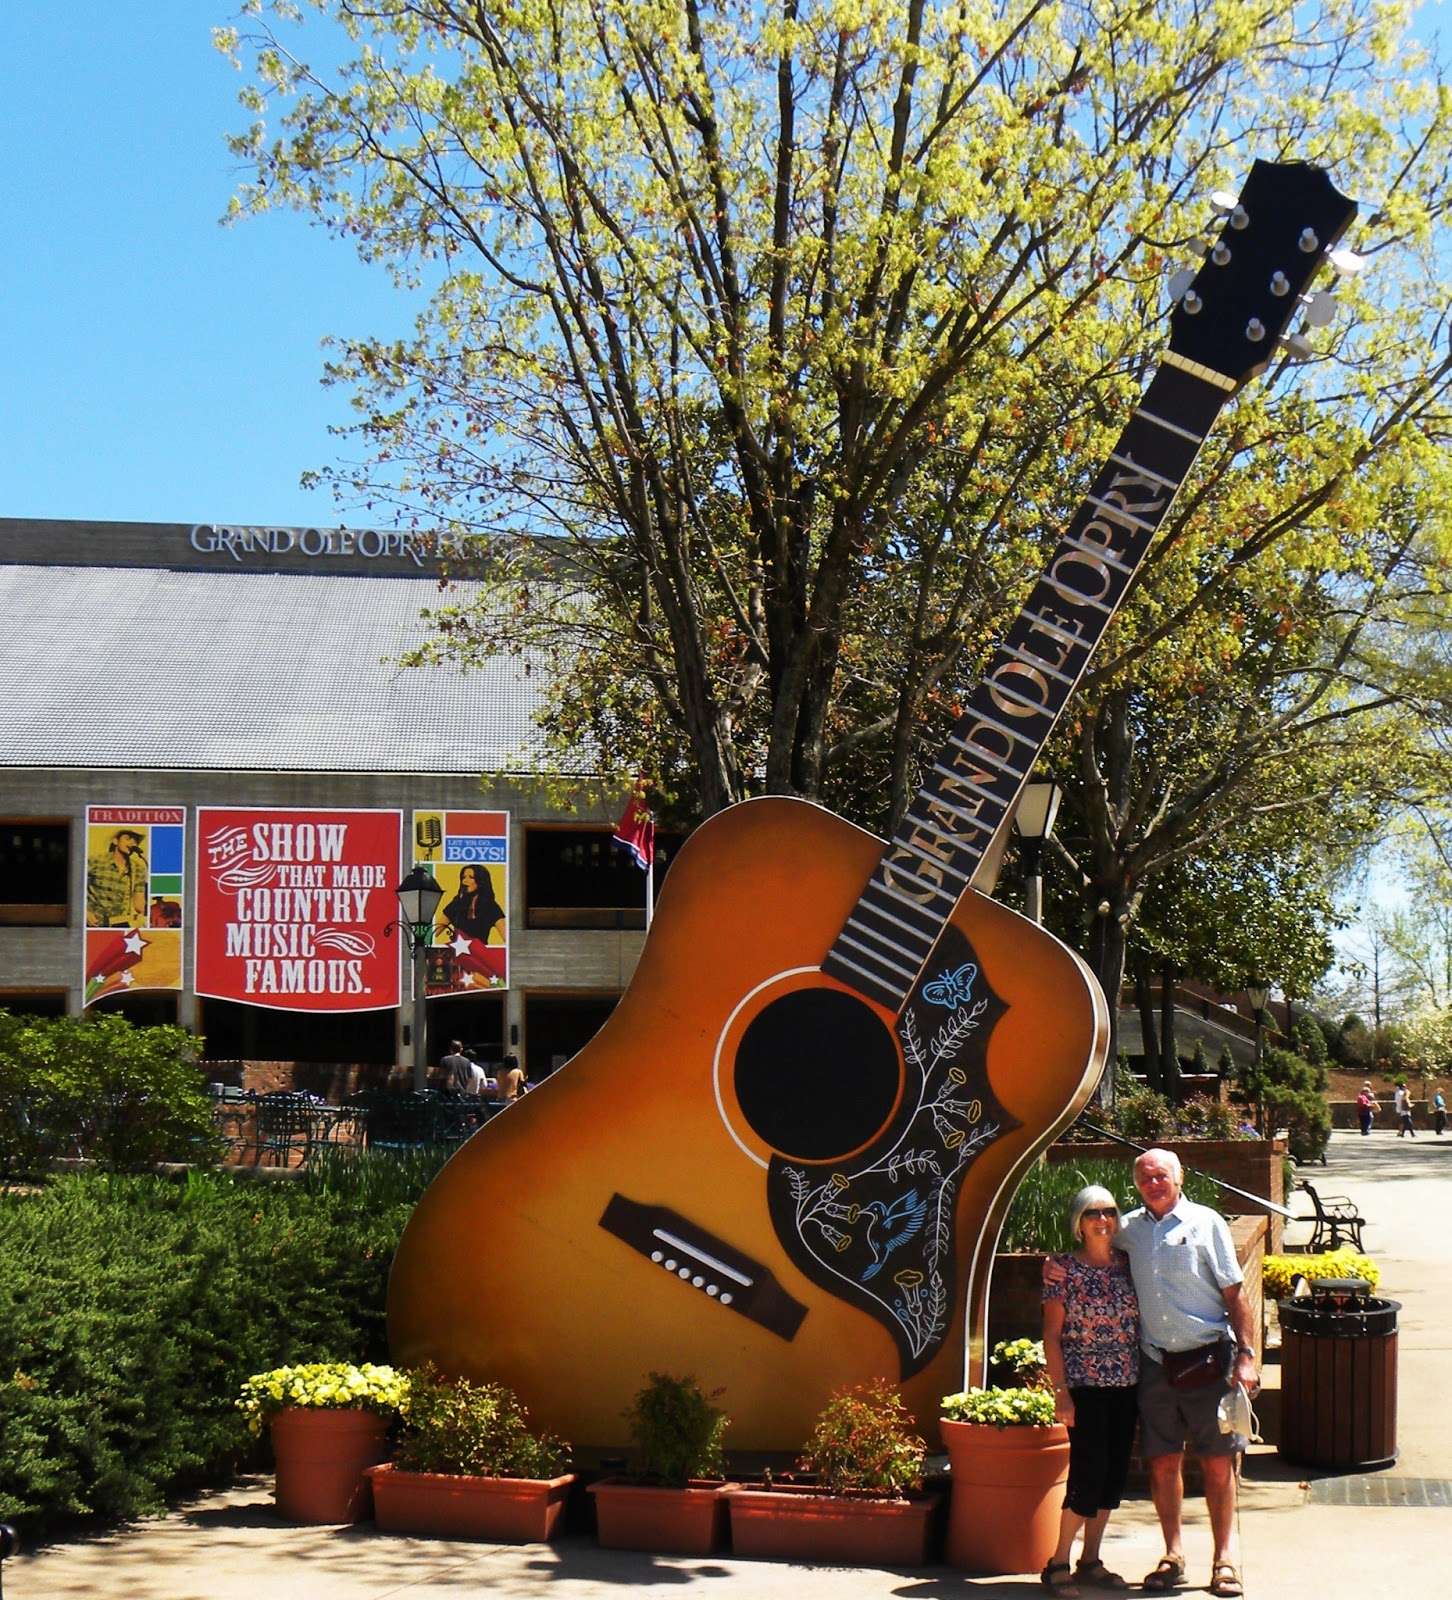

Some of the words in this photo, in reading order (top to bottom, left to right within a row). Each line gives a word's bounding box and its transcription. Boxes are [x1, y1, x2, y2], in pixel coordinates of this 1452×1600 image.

[190, 524, 294, 561] GRAND
[300, 528, 354, 556] OLE
[884, 721, 1014, 904] GRAND
[989, 606, 1084, 718] OLE
[1051, 451, 1167, 606] OPRY
[91, 809, 182, 822] TRADITION
[208, 834, 247, 863] THE
[252, 823, 348, 861] SHOW
[447, 846, 505, 861] BOYS!
[277, 865, 326, 887] THAT
[332, 865, 386, 888] MADE
[237, 888, 370, 922] COUNTRY
[226, 923, 316, 957] MUSIC
[245, 959, 371, 993] FAMOUS.
